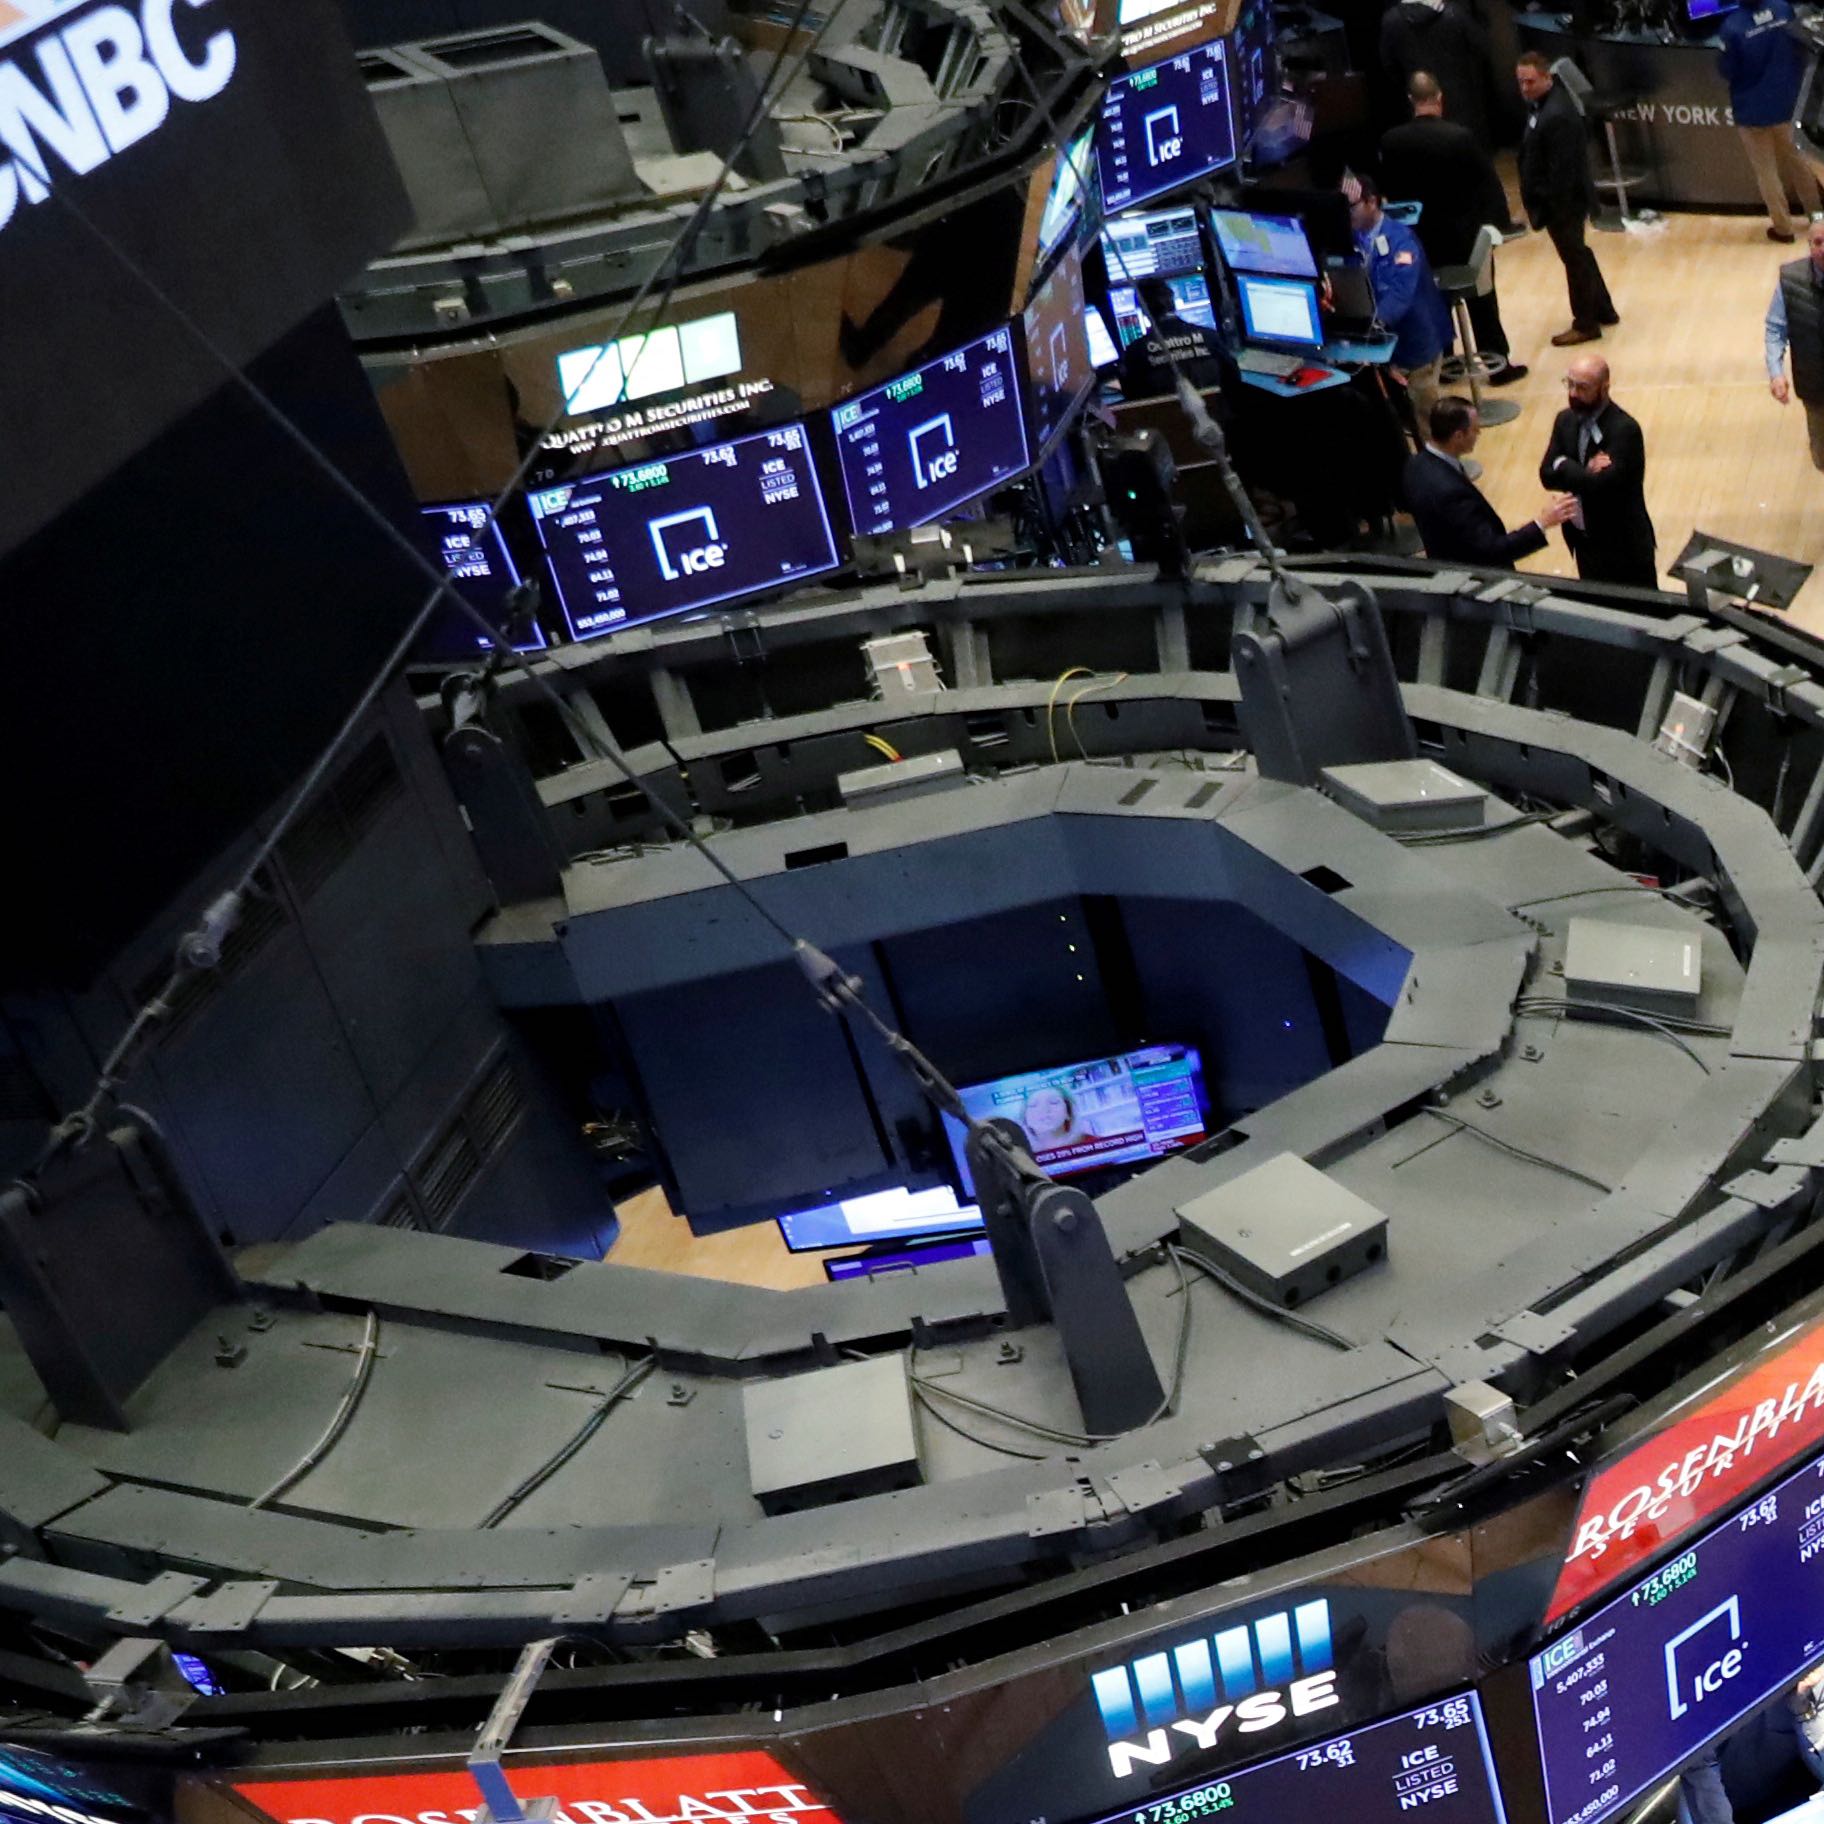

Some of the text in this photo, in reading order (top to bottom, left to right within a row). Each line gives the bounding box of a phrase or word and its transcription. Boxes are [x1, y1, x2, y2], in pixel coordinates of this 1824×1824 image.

[0, 0, 236, 231] NBC
[1662, 104, 1721, 126] YORK
[539, 418, 623, 450] QUATTO
[623, 411, 643, 429] M
[646, 389, 736, 423] SECURITIES
[762, 459, 786, 474] ICE
[542, 491, 567, 509] ICE
[764, 487, 799, 504] NYSE
[446, 535, 471, 550] ICE
[1109, 1670, 1339, 1778] NYSE
[1413, 1698, 1469, 1730] 73.65
[1296, 1740, 1352, 1771] 73.62
[1401, 1745, 1440, 1769] ICE
[1395, 1762, 1455, 1791] LISTED
[1148, 1782, 1232, 1823] 73.6800
[1400, 1779, 1459, 1811] NYSE
